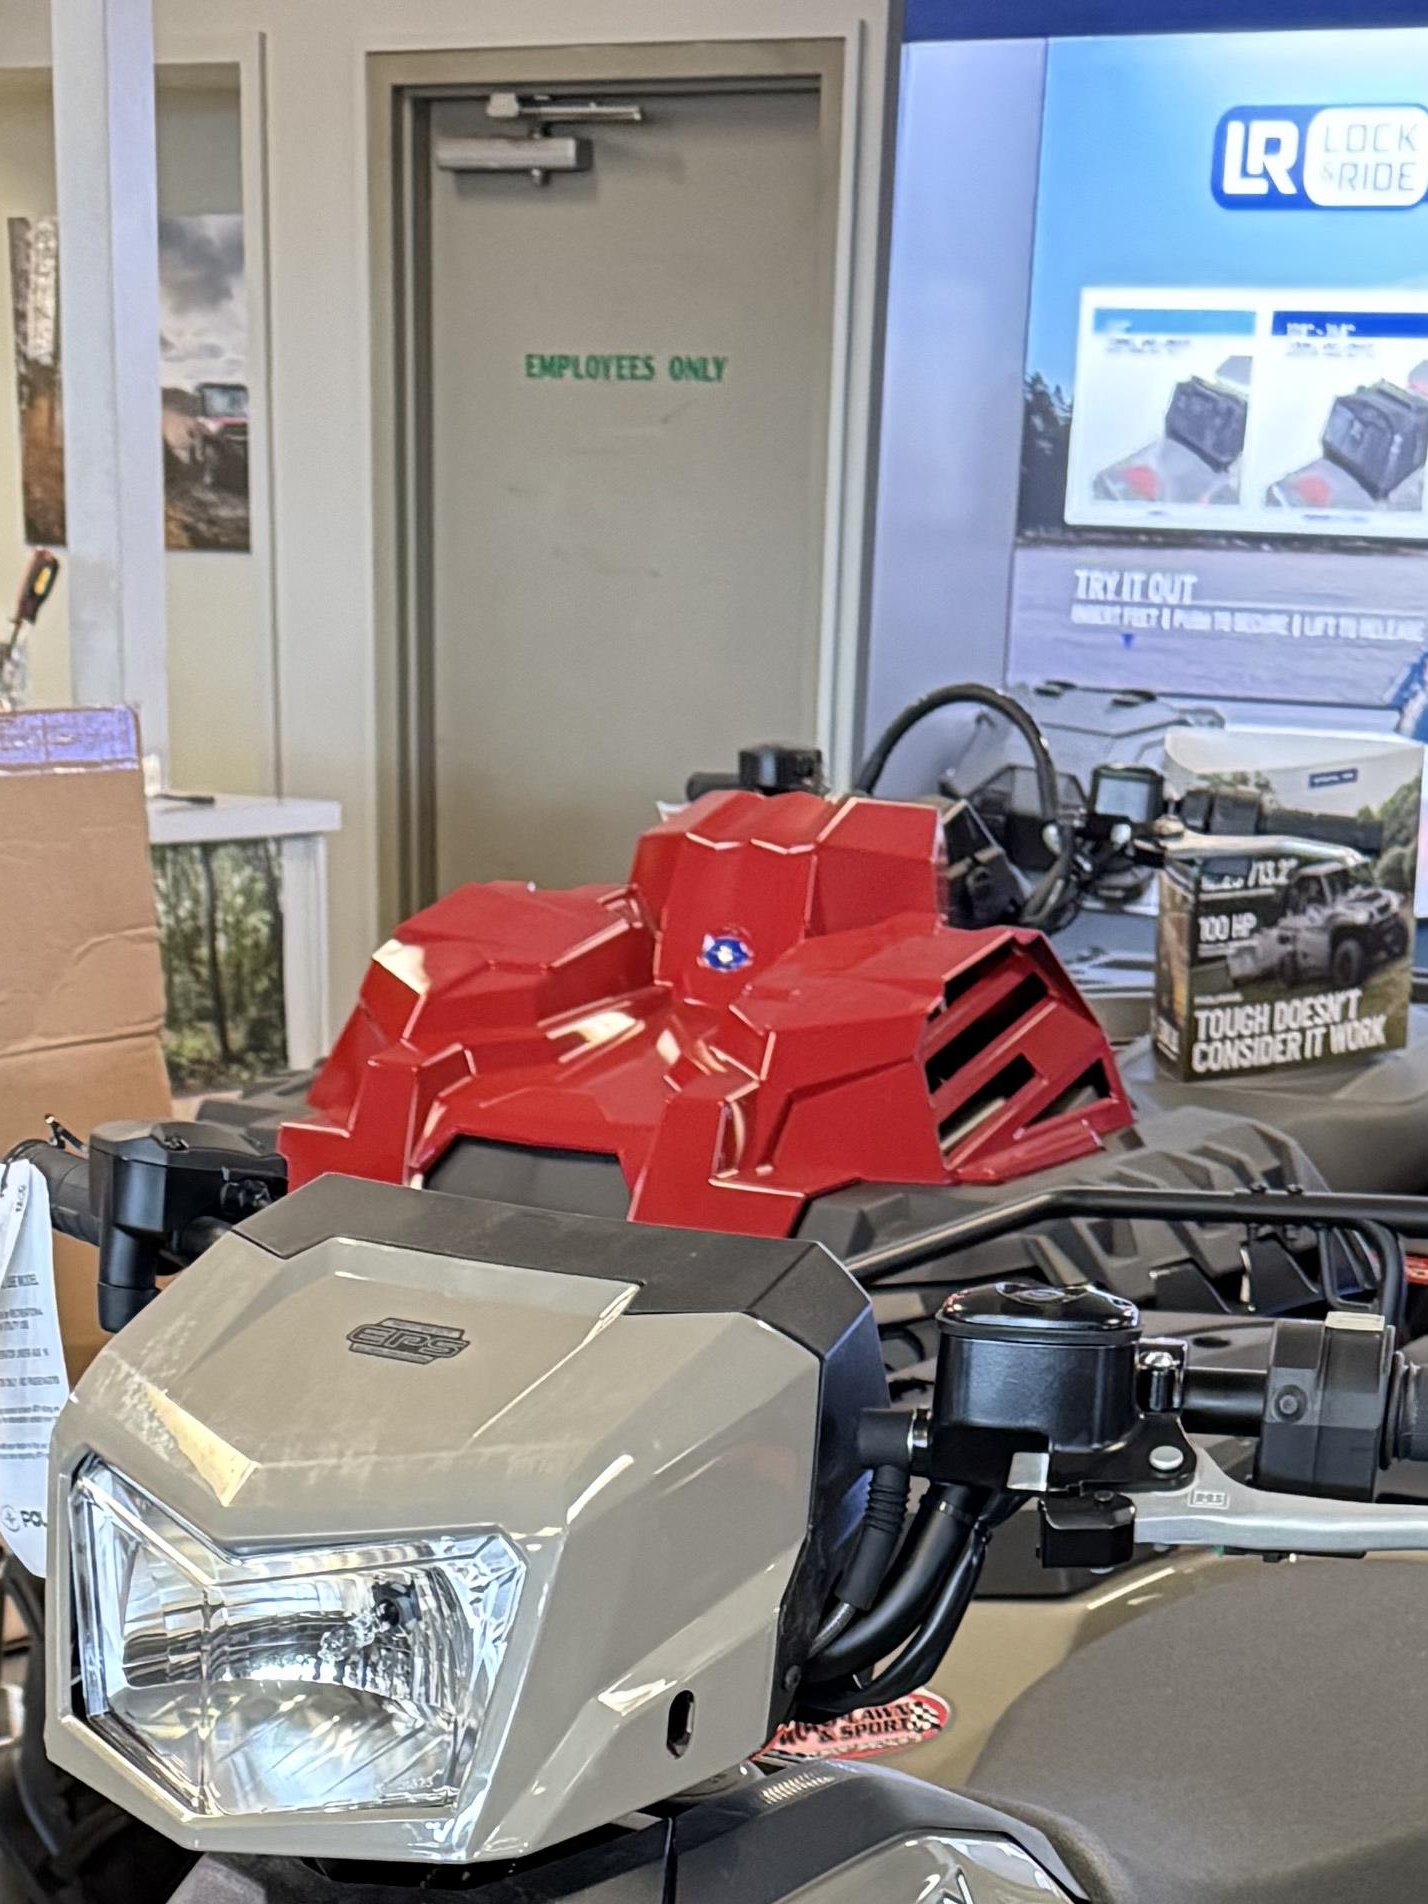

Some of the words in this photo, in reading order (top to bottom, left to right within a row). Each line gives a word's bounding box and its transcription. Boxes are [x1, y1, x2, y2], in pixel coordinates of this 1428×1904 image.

[1324, 123, 1417, 153] LOCK
[1223, 120, 1299, 195] LR
[1337, 161, 1417, 192] RIDE
[525, 354, 655, 381] EMPLOYEES
[669, 356, 727, 382] ONLY
[1074, 569, 1121, 601] TRY
[1123, 571, 1148, 602] IT
[1148, 572, 1199, 605] OUT
[1198, 914, 1230, 942] 100
[1232, 912, 1257, 938] HP
[1194, 1002, 1271, 1041] TOUGH
[1273, 988, 1363, 1033] DOESN'T
[1191, 1032, 1303, 1073] CONSIDER
[1304, 1027, 1329, 1060] IT
[1329, 1014, 1387, 1055] WORK
[346, 1324, 470, 1358] EPS
